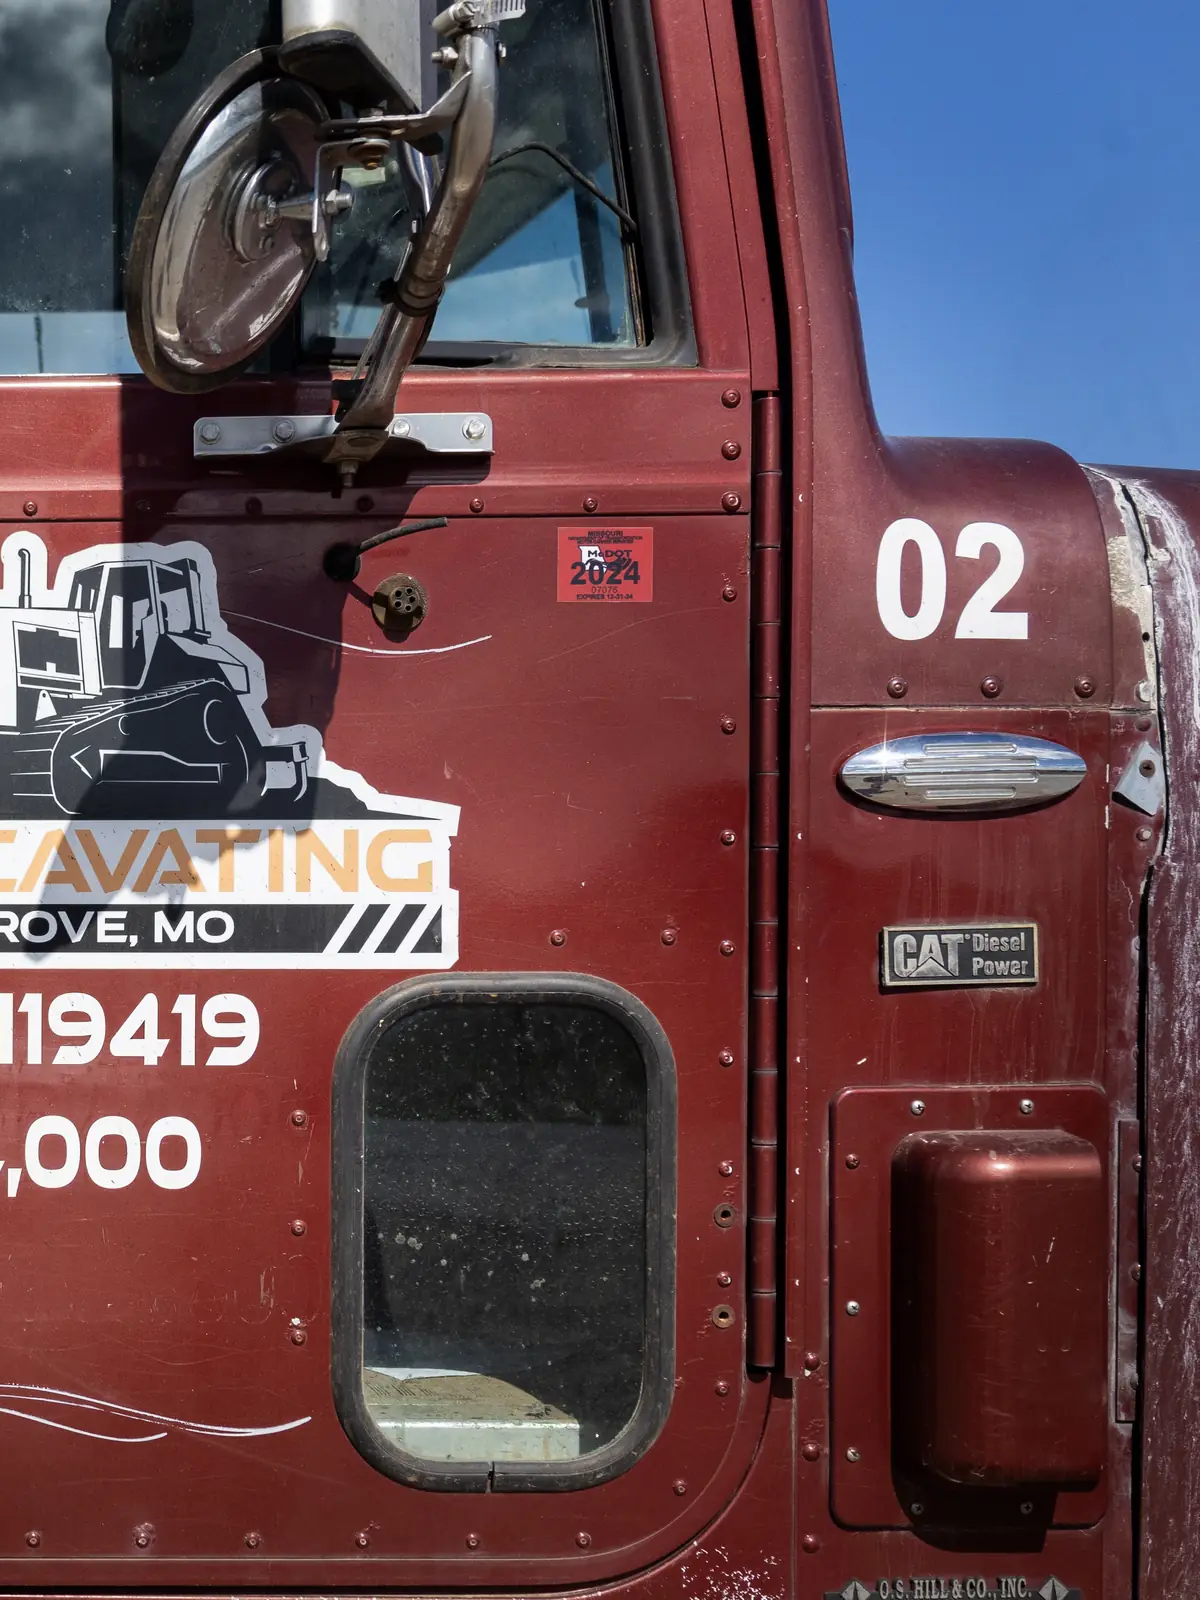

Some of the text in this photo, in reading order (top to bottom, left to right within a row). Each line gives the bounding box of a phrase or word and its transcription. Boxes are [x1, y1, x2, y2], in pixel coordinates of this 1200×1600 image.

[570, 561, 640, 585] 2024
[876, 518, 1028, 640] 02
[154, 910, 235, 943] MO
[893, 932, 1026, 978] CAT Diesel
[972, 957, 1029, 977] Power
[879, 1577, 1032, 1600] O.S. HILL & CO., INC.
